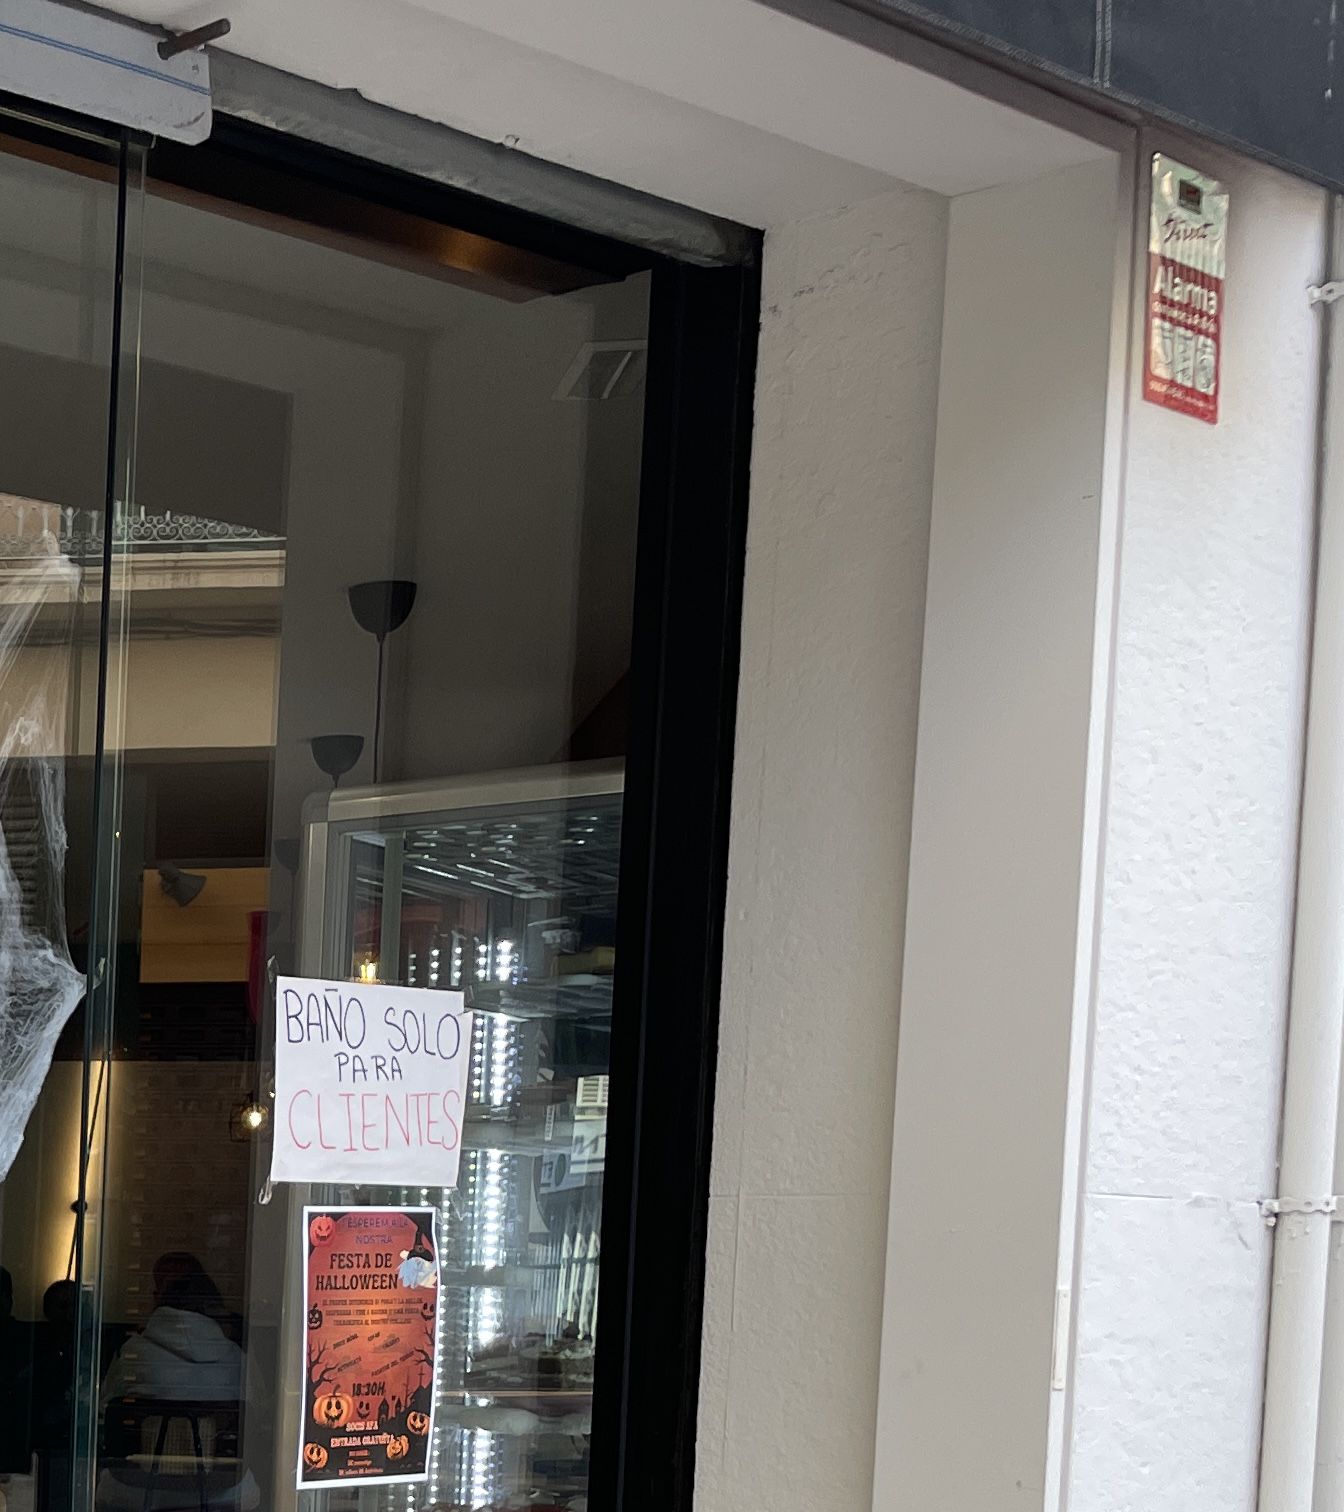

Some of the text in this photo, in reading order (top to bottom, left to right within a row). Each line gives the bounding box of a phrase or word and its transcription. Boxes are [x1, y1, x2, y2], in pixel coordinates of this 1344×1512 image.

[1152, 265, 1218, 315] Alarma
[283, 987, 461, 1060] BAÑO SOLO
[333, 1051, 403, 1083] PARA
[288, 1088, 461, 1152] CLIENTES
[355, 1235, 394, 1245] NOSTRA
[329, 1252, 393, 1270] FESTA DE
[315, 1273, 399, 1291] HALLOWEEN
